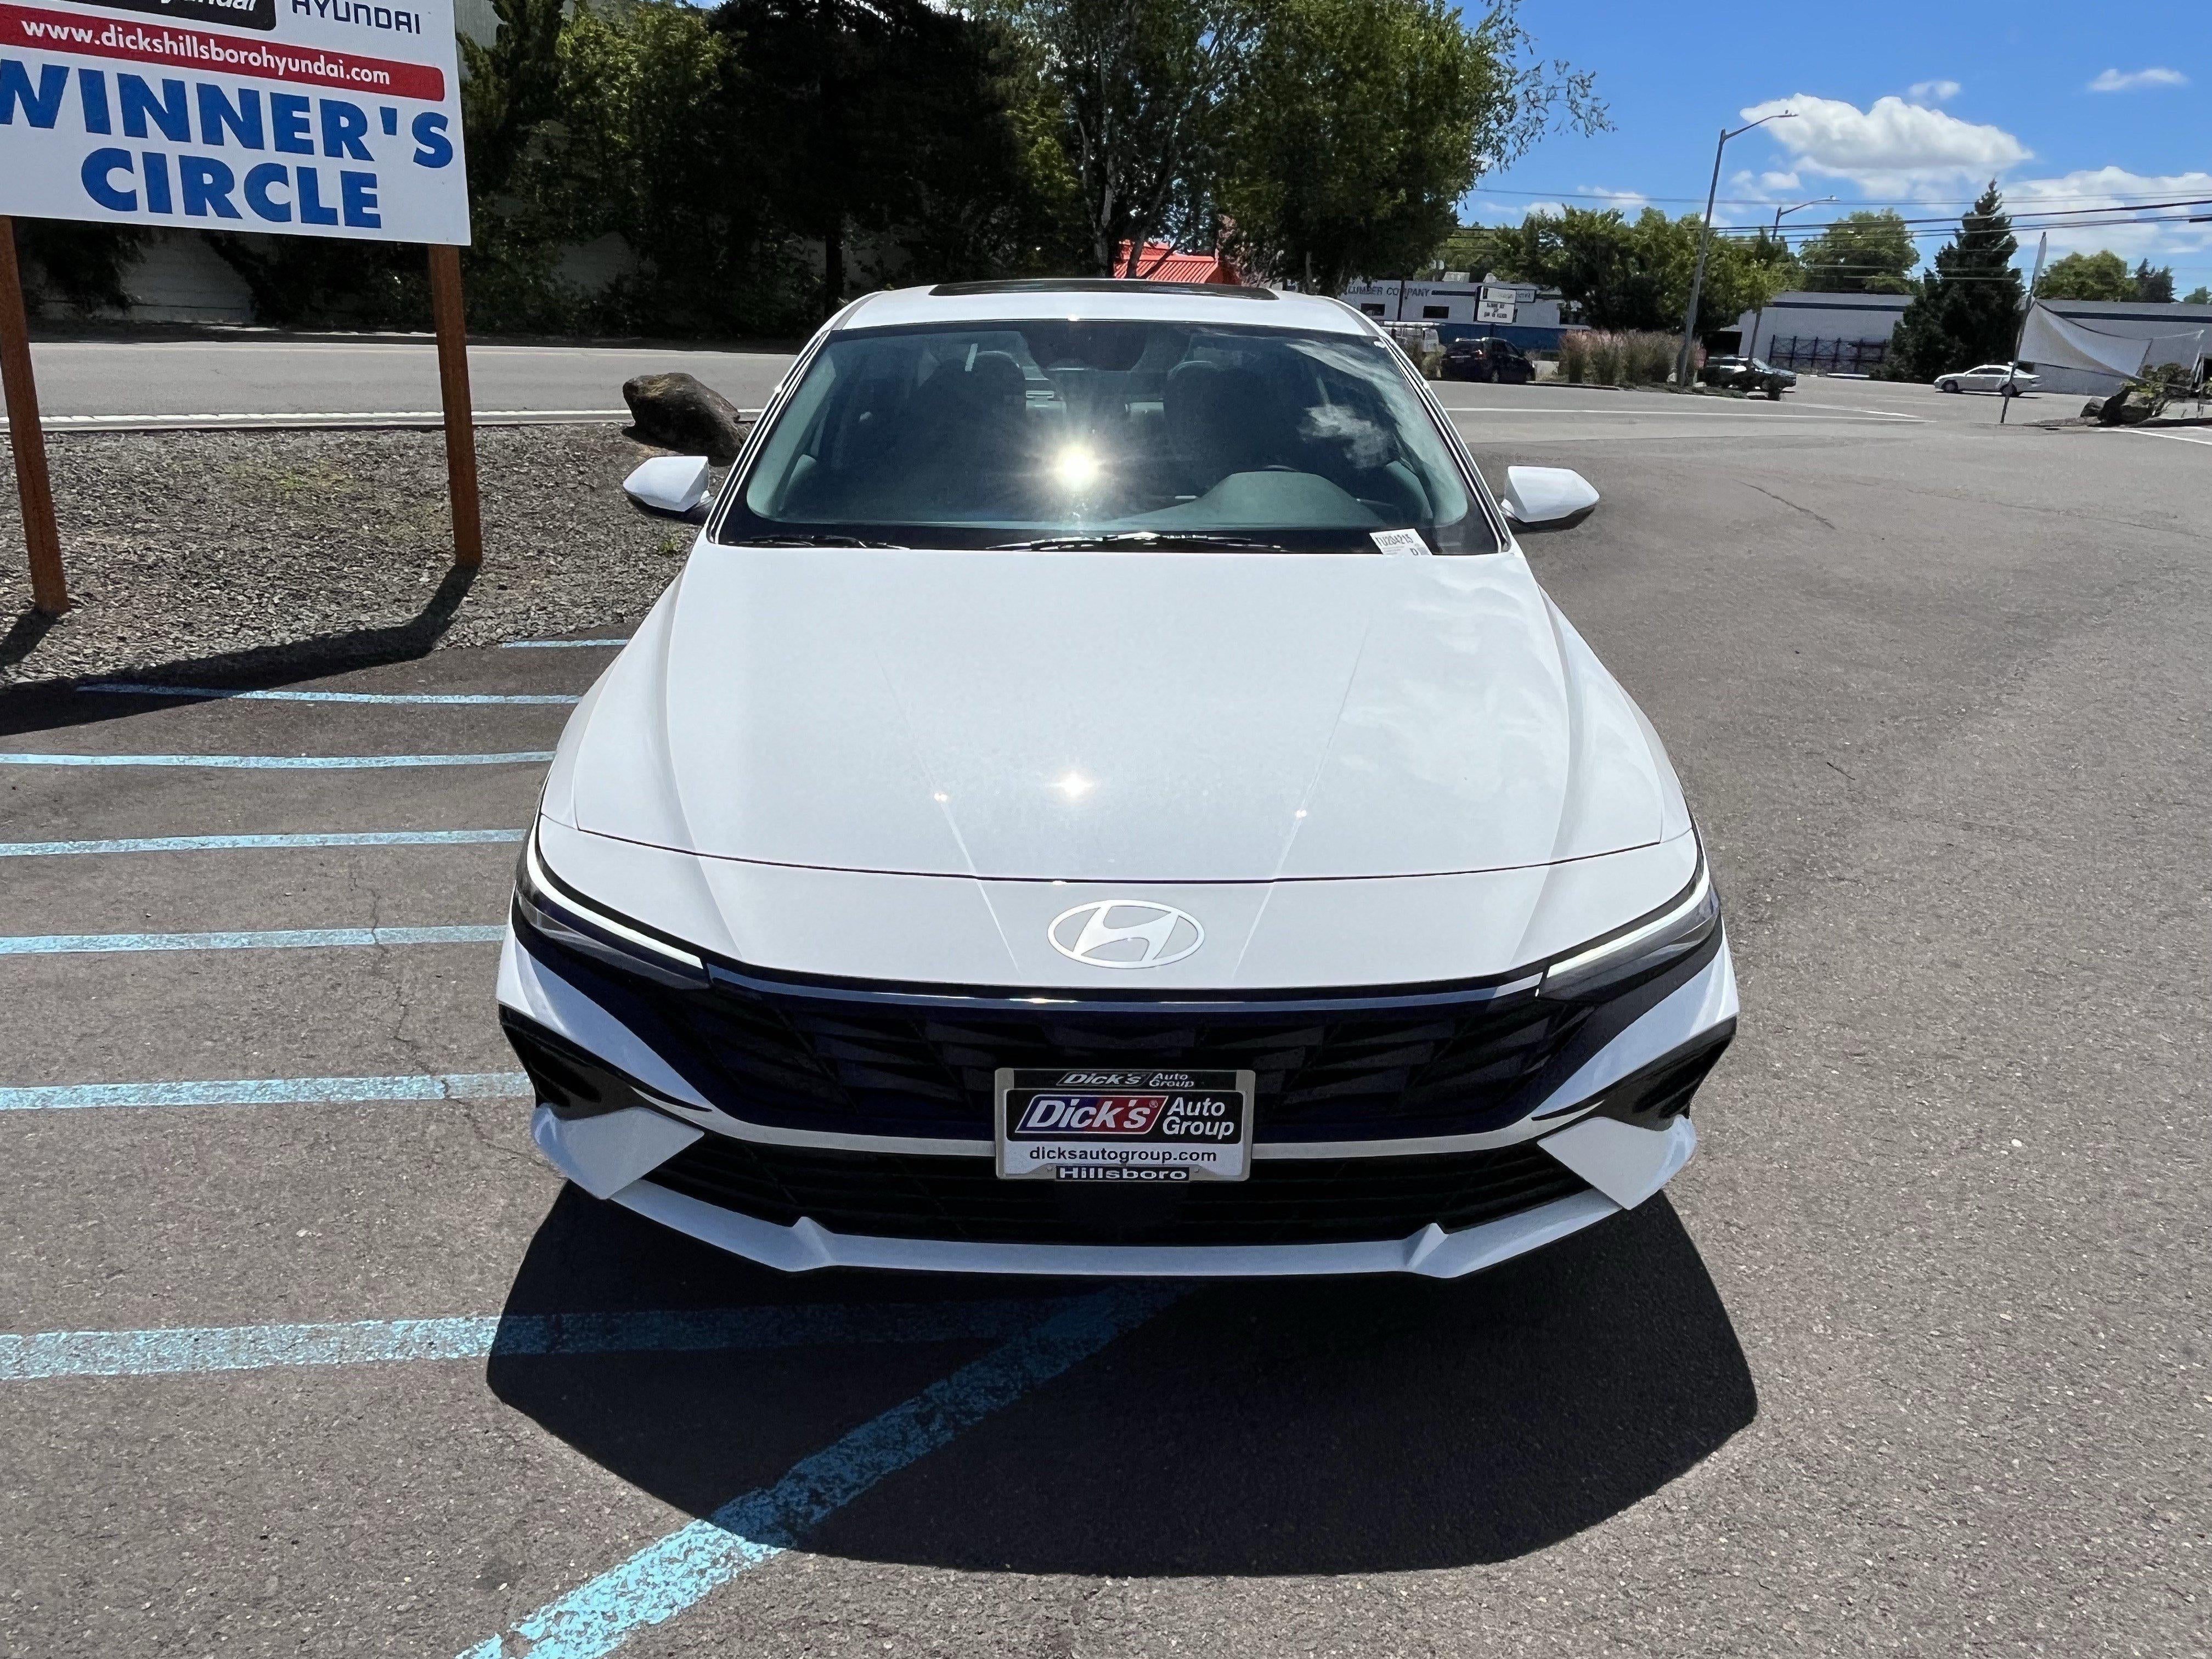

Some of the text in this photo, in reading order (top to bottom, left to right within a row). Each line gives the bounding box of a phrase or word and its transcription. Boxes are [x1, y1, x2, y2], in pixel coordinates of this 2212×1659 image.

[292, 0, 420, 35] HYUNDAI
[21, 20, 391, 86] www.dickshillsborohyundai.com
[0, 59, 453, 169] WINNER'S
[81, 148, 382, 229] CIRCLE
[1386, 287, 1430, 297] COPANY
[1064, 1073, 1142, 1085] Dick's
[1149, 1080, 1194, 1088] Group
[1026, 1098, 1150, 1128] Dick's
[1167, 1097, 1226, 1116] Auto
[1162, 1116, 1234, 1139] Group
[1029, 1146, 1217, 1163] dicksautogroup.com
[1059, 1166, 1187, 1180] Hillsboro
